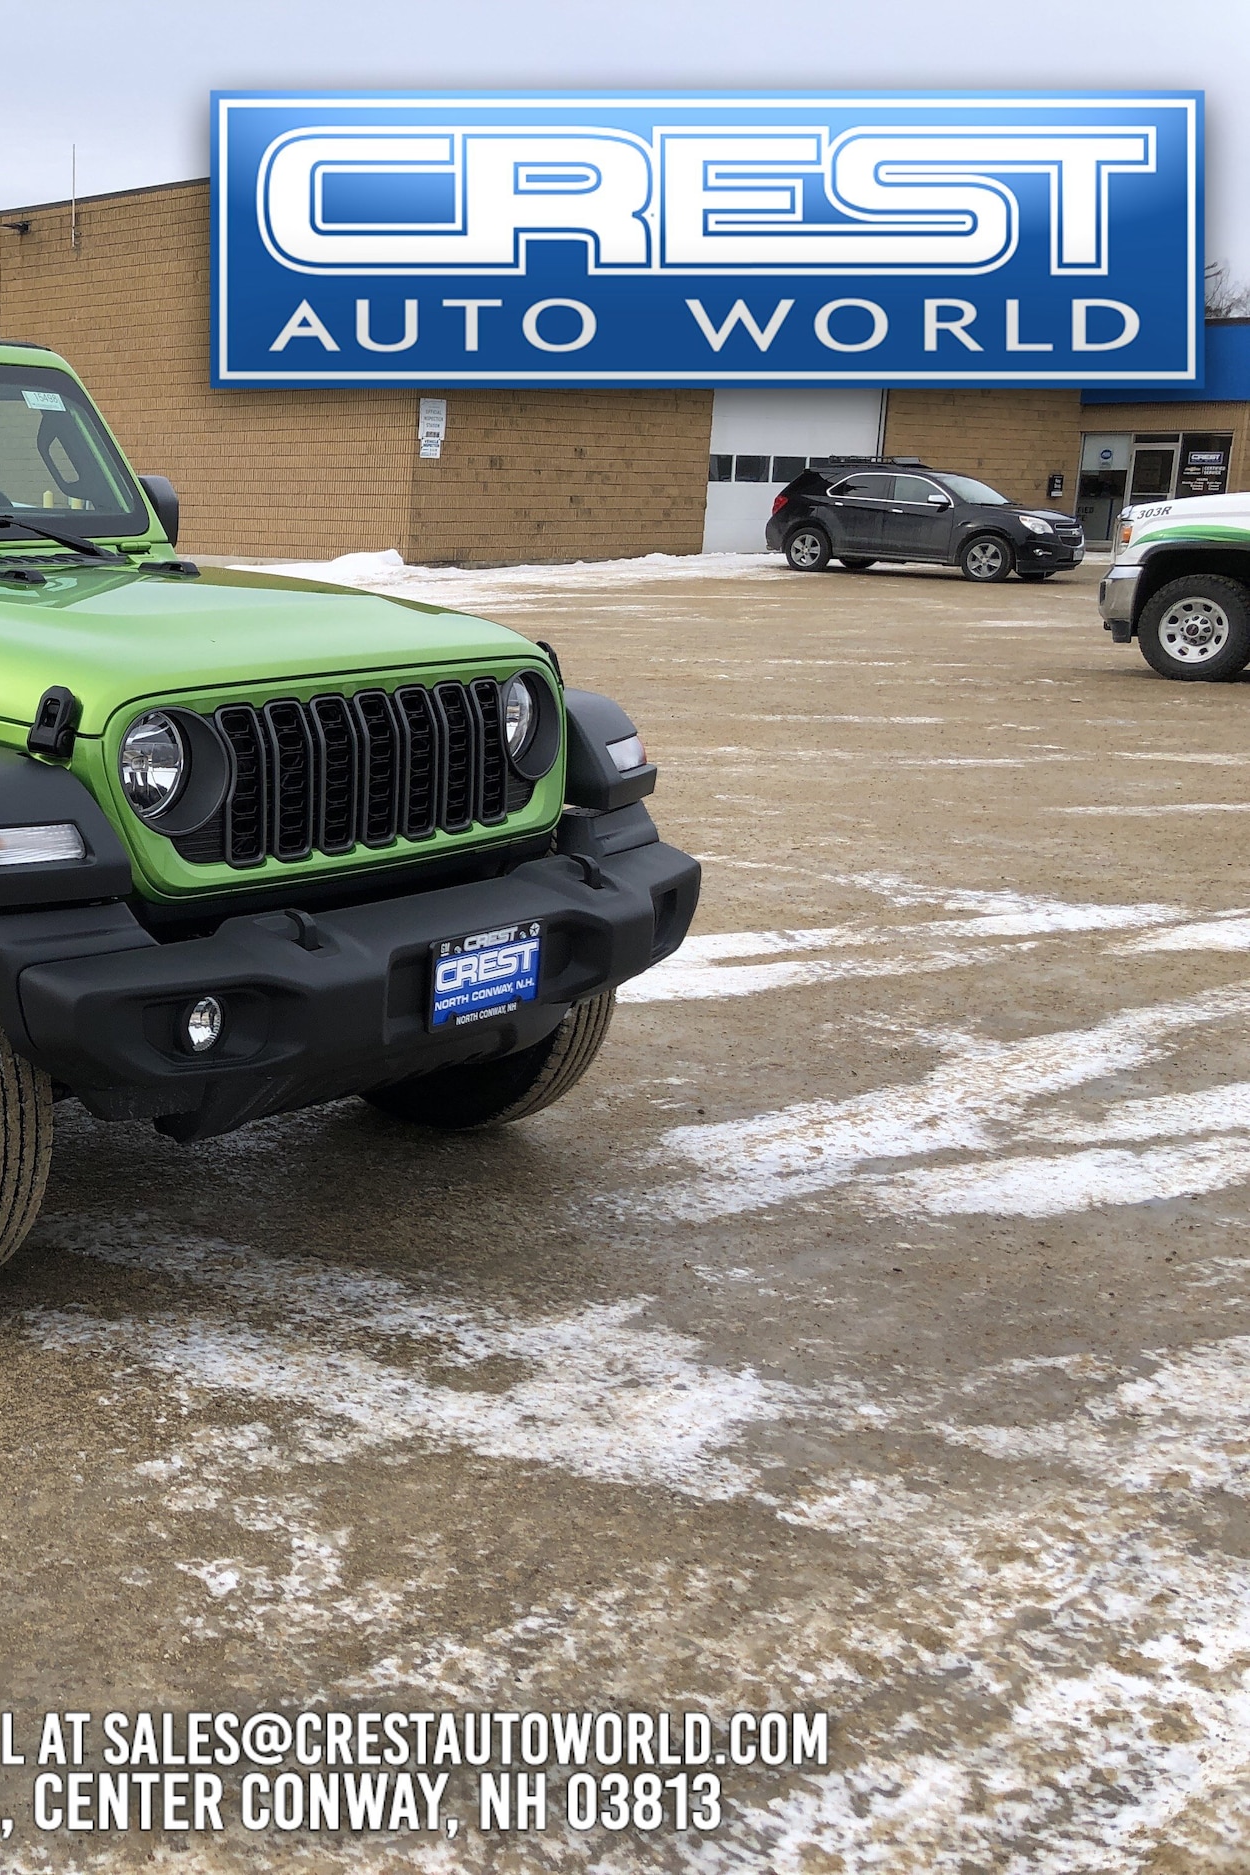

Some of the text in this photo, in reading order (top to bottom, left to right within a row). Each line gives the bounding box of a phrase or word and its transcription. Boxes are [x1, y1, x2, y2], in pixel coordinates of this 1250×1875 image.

[1137, 506, 1172, 519] 303R
[463, 926, 519, 952] CREST
[435, 938, 540, 994] CREST
[434, 976, 535, 1012] NORTH CONWAY, N.H.
[456, 1001, 517, 1026] NORTH CONWAY, NH
